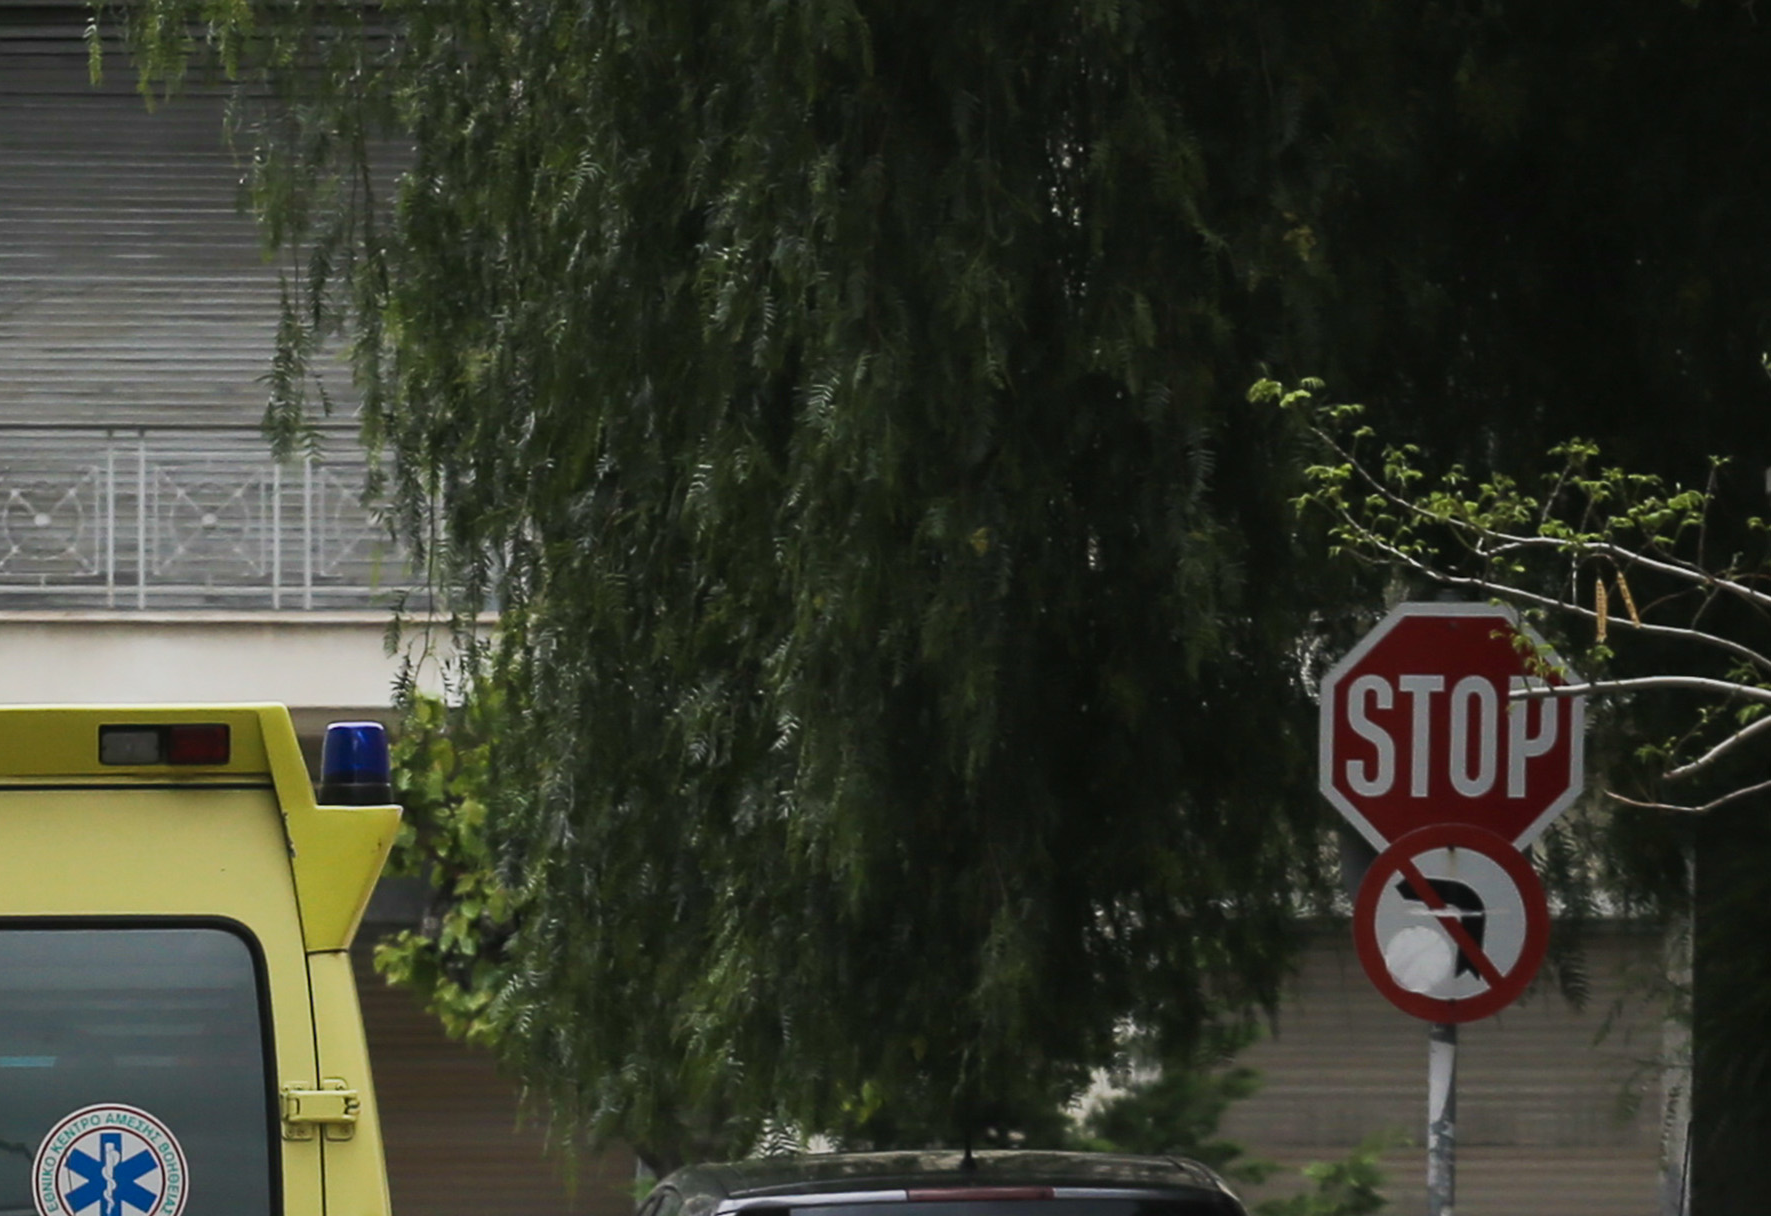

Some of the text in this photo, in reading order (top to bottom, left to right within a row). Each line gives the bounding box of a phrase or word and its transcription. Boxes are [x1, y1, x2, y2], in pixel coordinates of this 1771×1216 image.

[1345, 674, 1559, 798] STOP
[41, 1113, 181, 1216] ΕΘΝΙΚΟ ΚΕΝΤΡΟ ΑΜΕΣΗΣ ΒΟΗΘΕΙΑΣ
